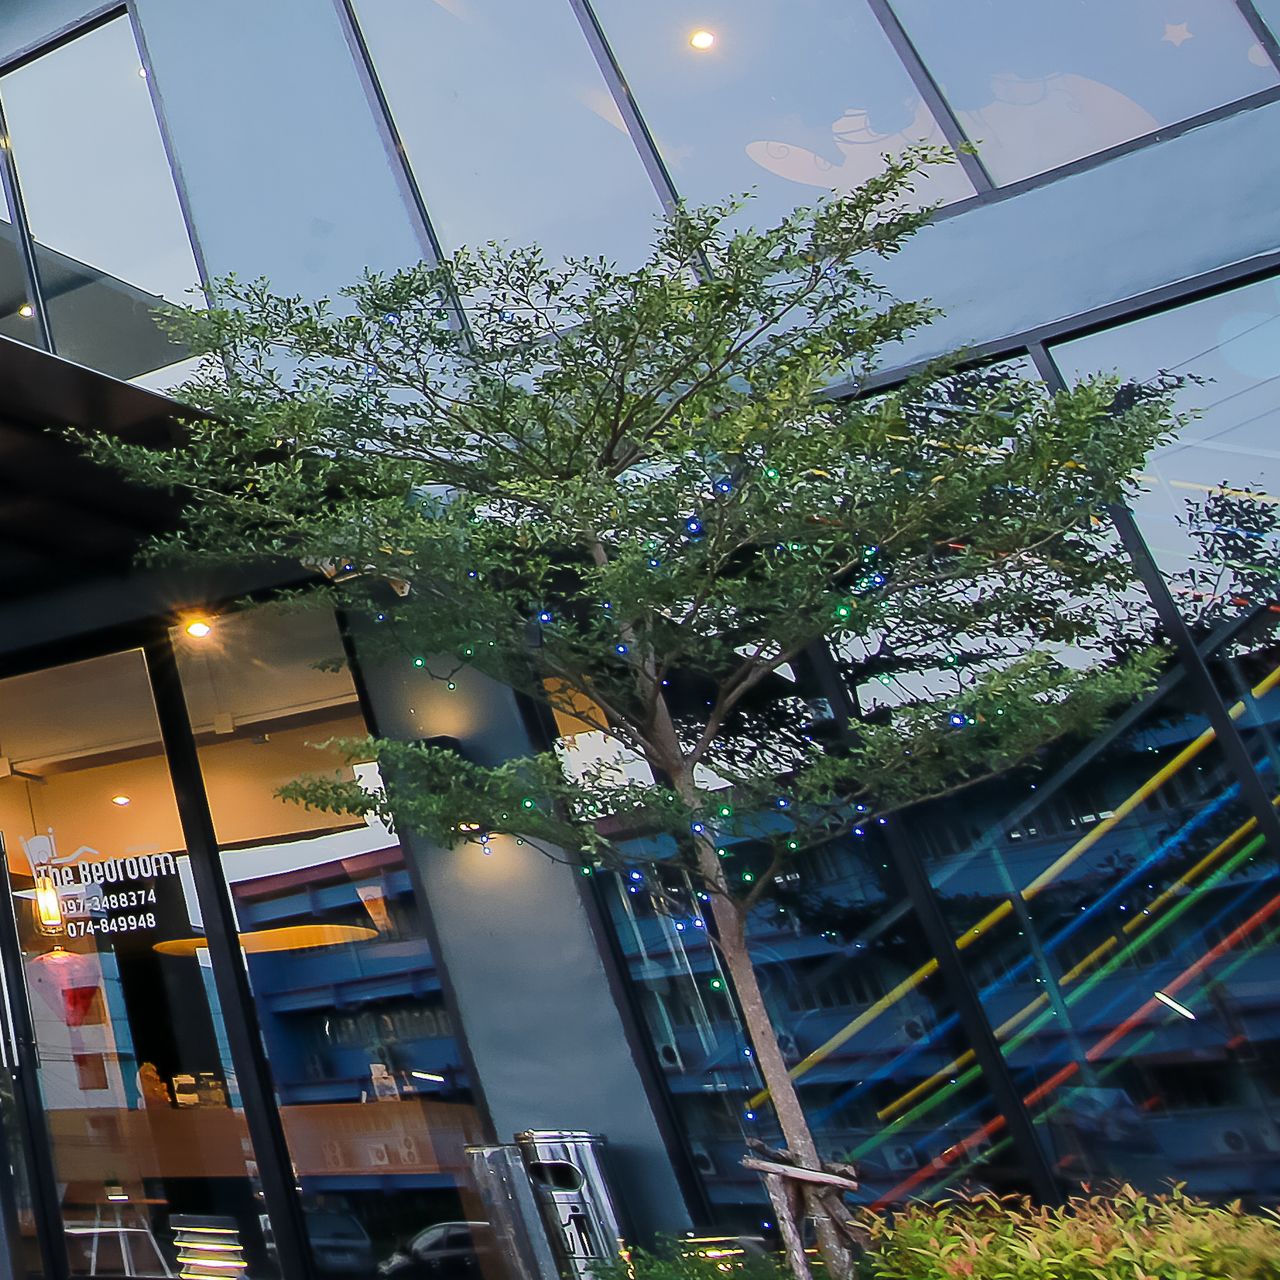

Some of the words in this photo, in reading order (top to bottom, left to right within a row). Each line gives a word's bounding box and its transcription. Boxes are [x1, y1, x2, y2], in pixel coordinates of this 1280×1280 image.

[36, 865, 74, 888] The
[78, 853, 176, 887] Bedroom
[66, 912, 157, 938] 074-849948
